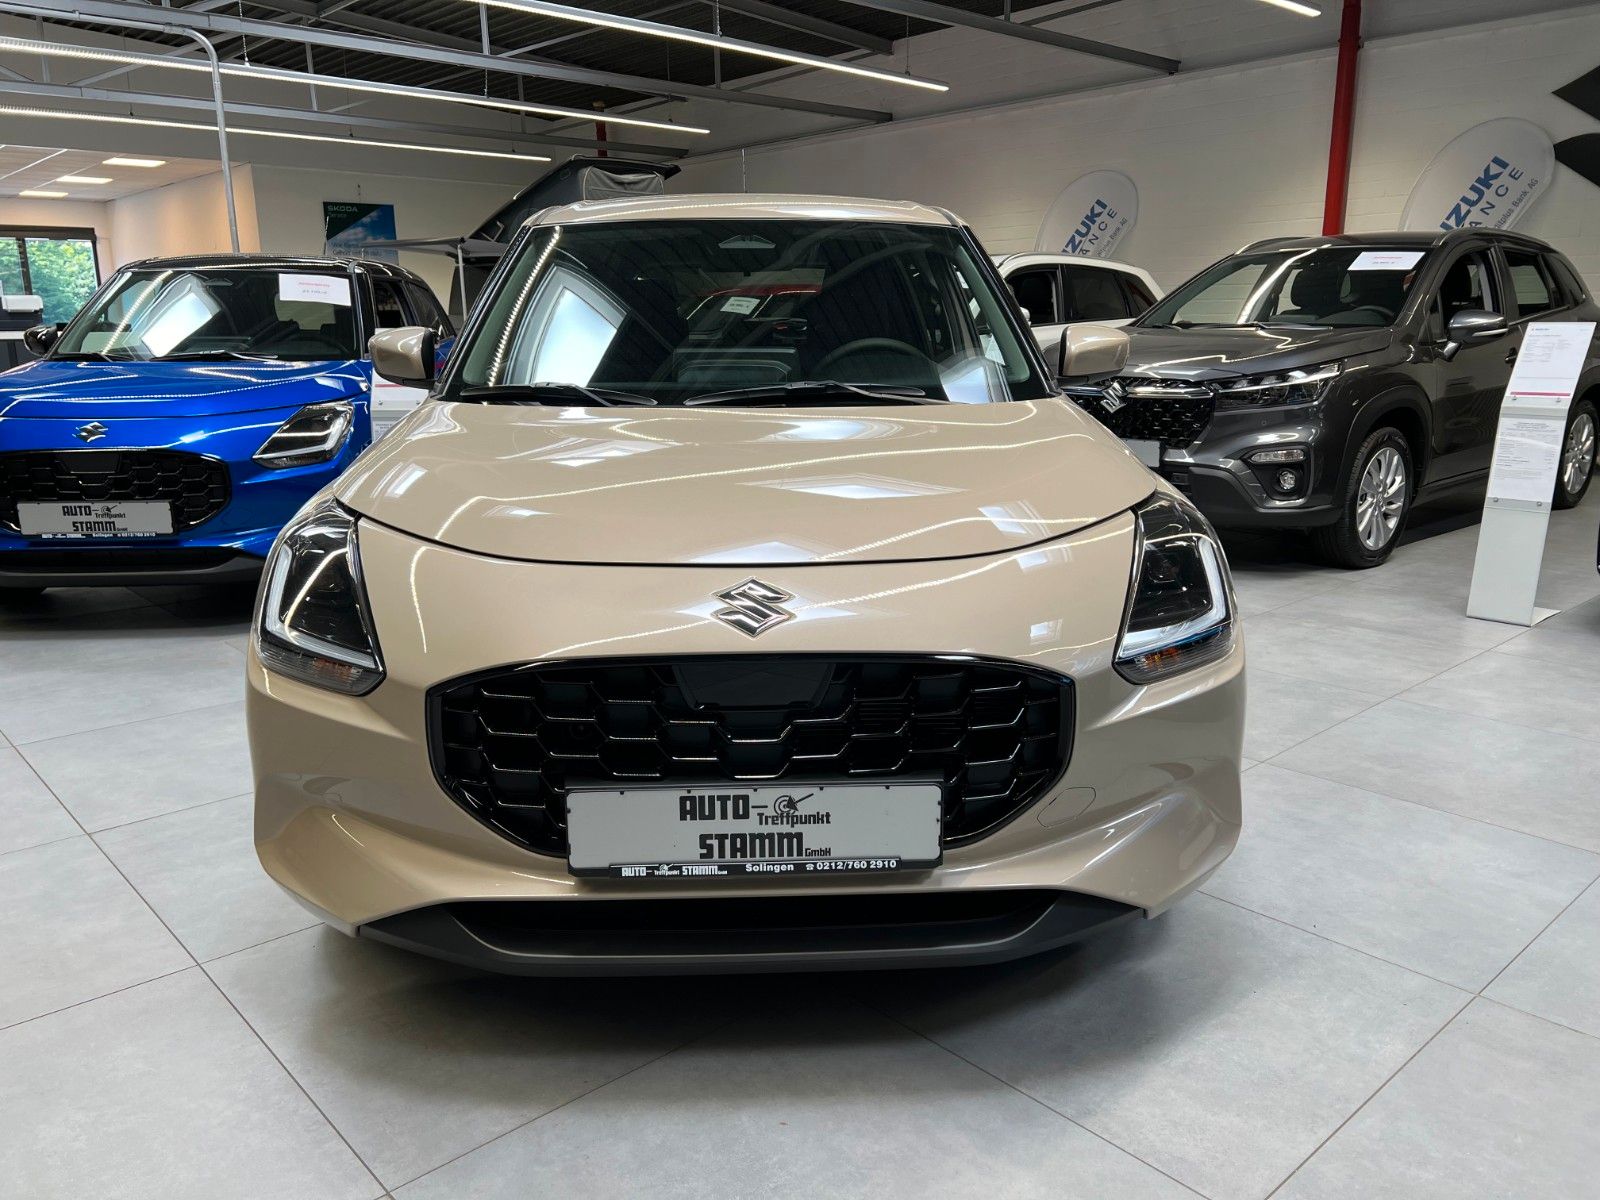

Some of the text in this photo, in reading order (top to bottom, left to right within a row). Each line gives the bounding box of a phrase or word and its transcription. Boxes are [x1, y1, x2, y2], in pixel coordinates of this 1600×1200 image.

[1440, 156, 1510, 231] ZUKI
[1469, 167, 1524, 228] ANCE
[1527, 178, 1539, 190] AG
[1061, 199, 1108, 253] ZUKI
[1081, 208, 1118, 255] ANCE
[72, 521, 116, 531] STAMM
[757, 811, 832, 828] Treffpunkt
[699, 831, 832, 859] STAMM GmbH
[682, 865, 718, 876] STAMM
[745, 863, 794, 873] Solingen
[816, 860, 867, 870] 0212/760
[869, 860, 897, 869] 2910
